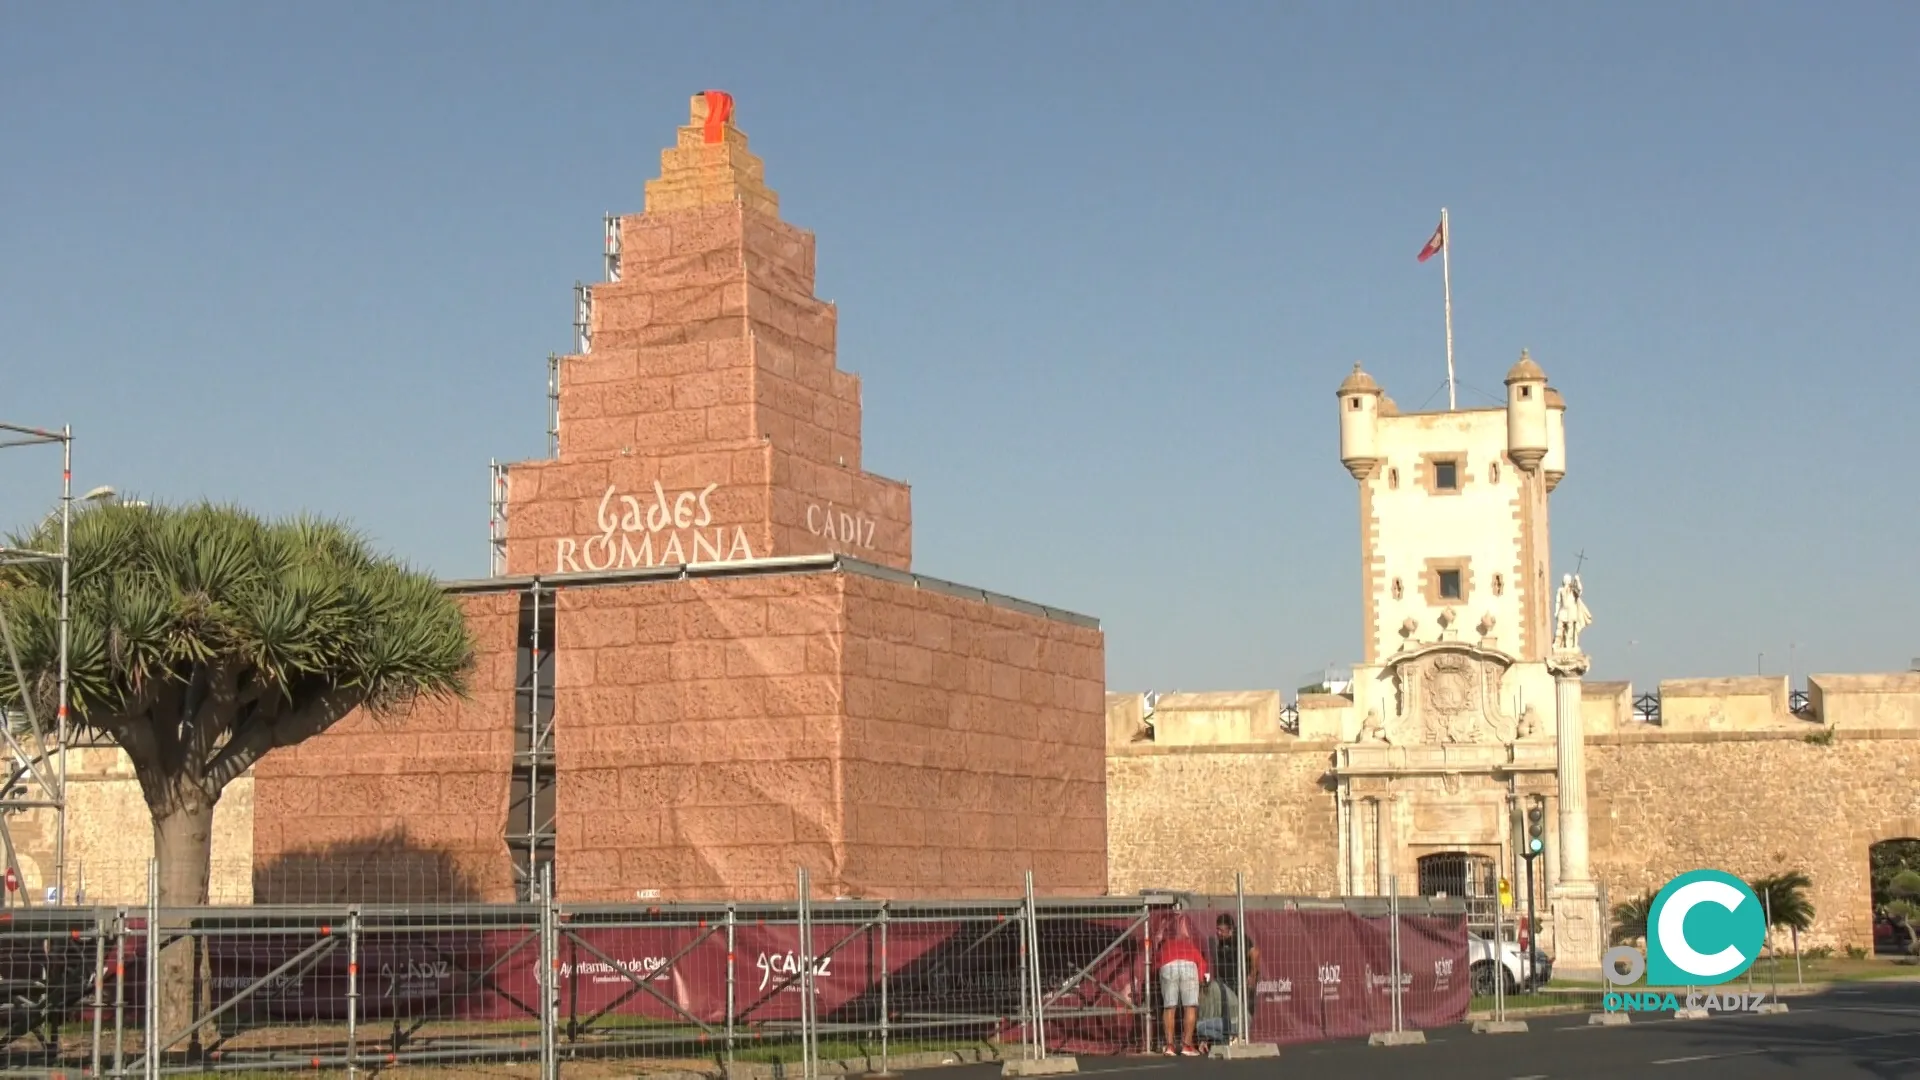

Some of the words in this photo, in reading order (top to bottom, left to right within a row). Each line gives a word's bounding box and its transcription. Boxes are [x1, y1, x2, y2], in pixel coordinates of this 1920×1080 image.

[555, 525, 755, 574] ROMANA
[807, 501, 876, 550] CÁDIZ
[629, 957, 641, 972] de
